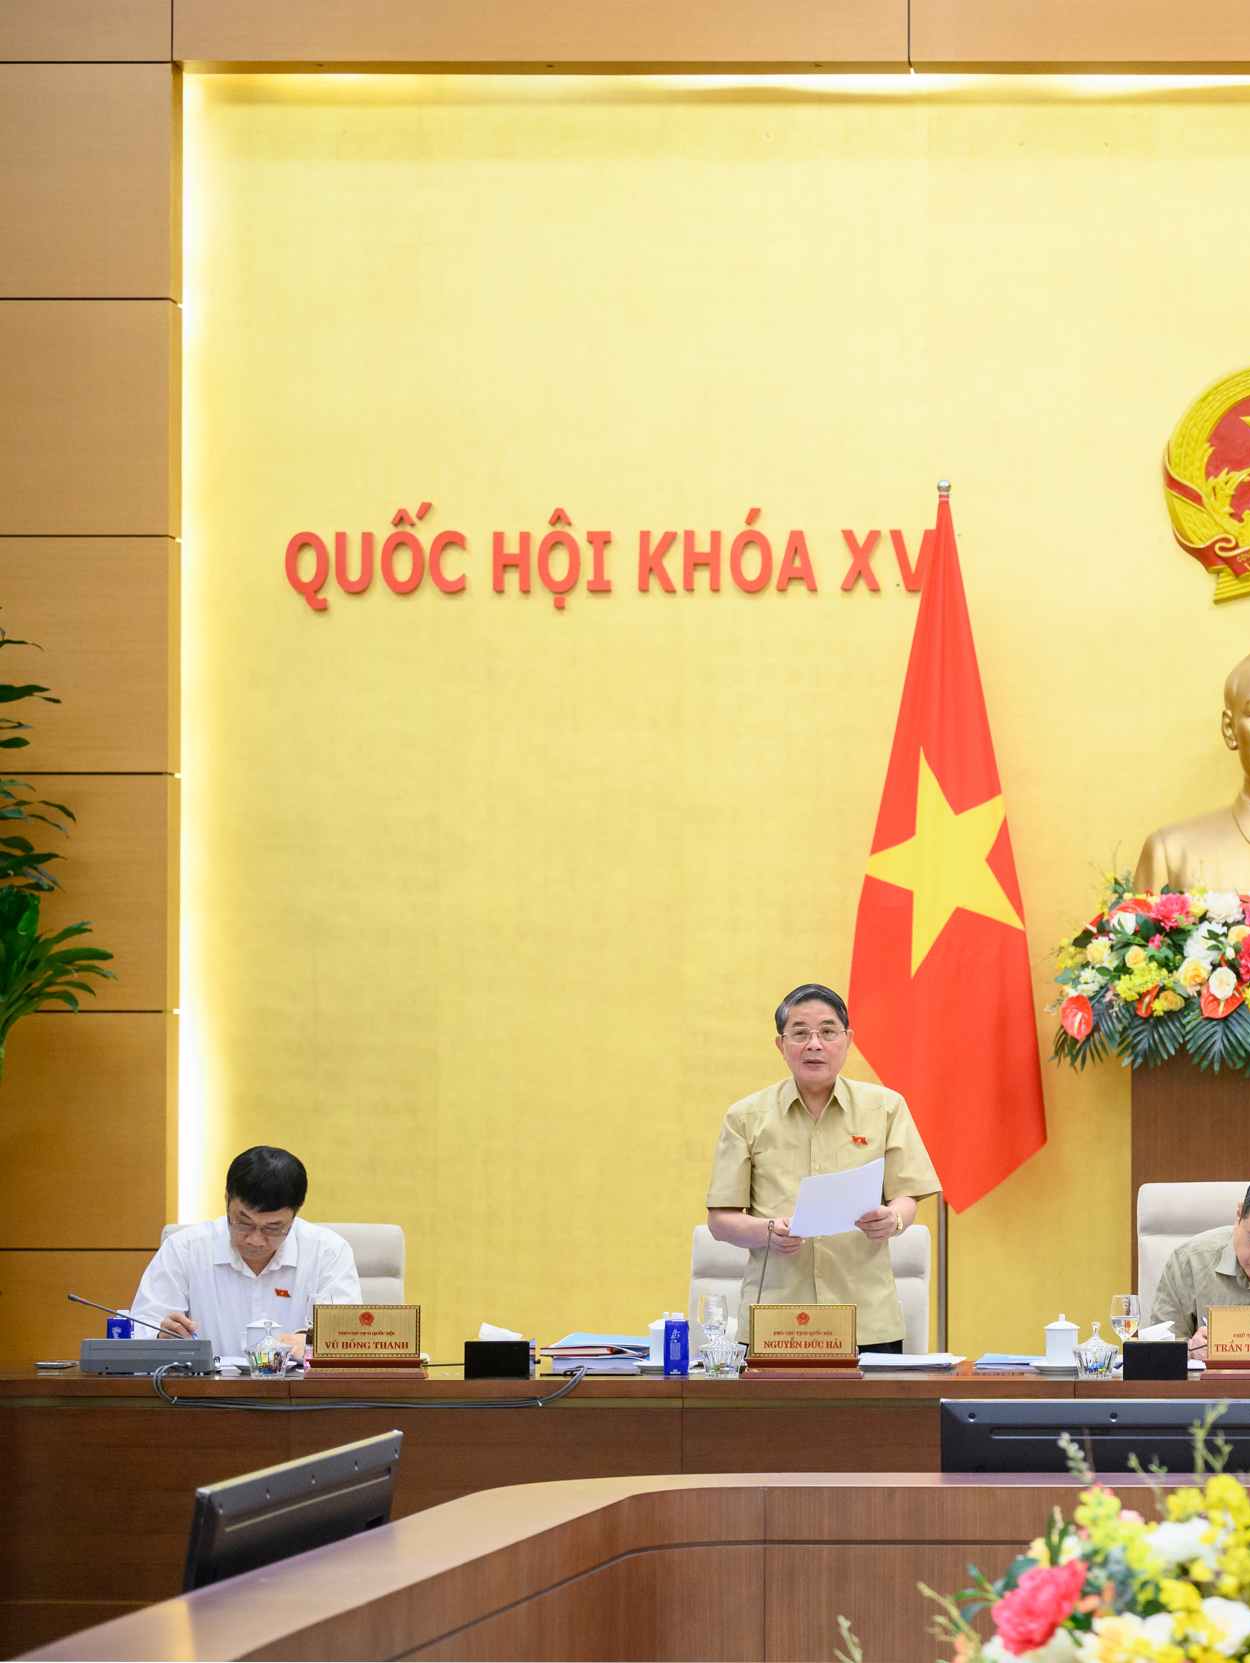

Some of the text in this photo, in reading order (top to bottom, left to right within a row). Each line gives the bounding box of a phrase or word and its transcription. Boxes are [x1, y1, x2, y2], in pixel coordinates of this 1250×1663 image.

[285, 502, 937, 610] QUỐC HỘI KHÓA XV
[325, 1339, 339, 1349] VŨ
[373, 1341, 409, 1349] THANH
[763, 1337, 843, 1349] NGUYỄN ĐỨC HẢI
